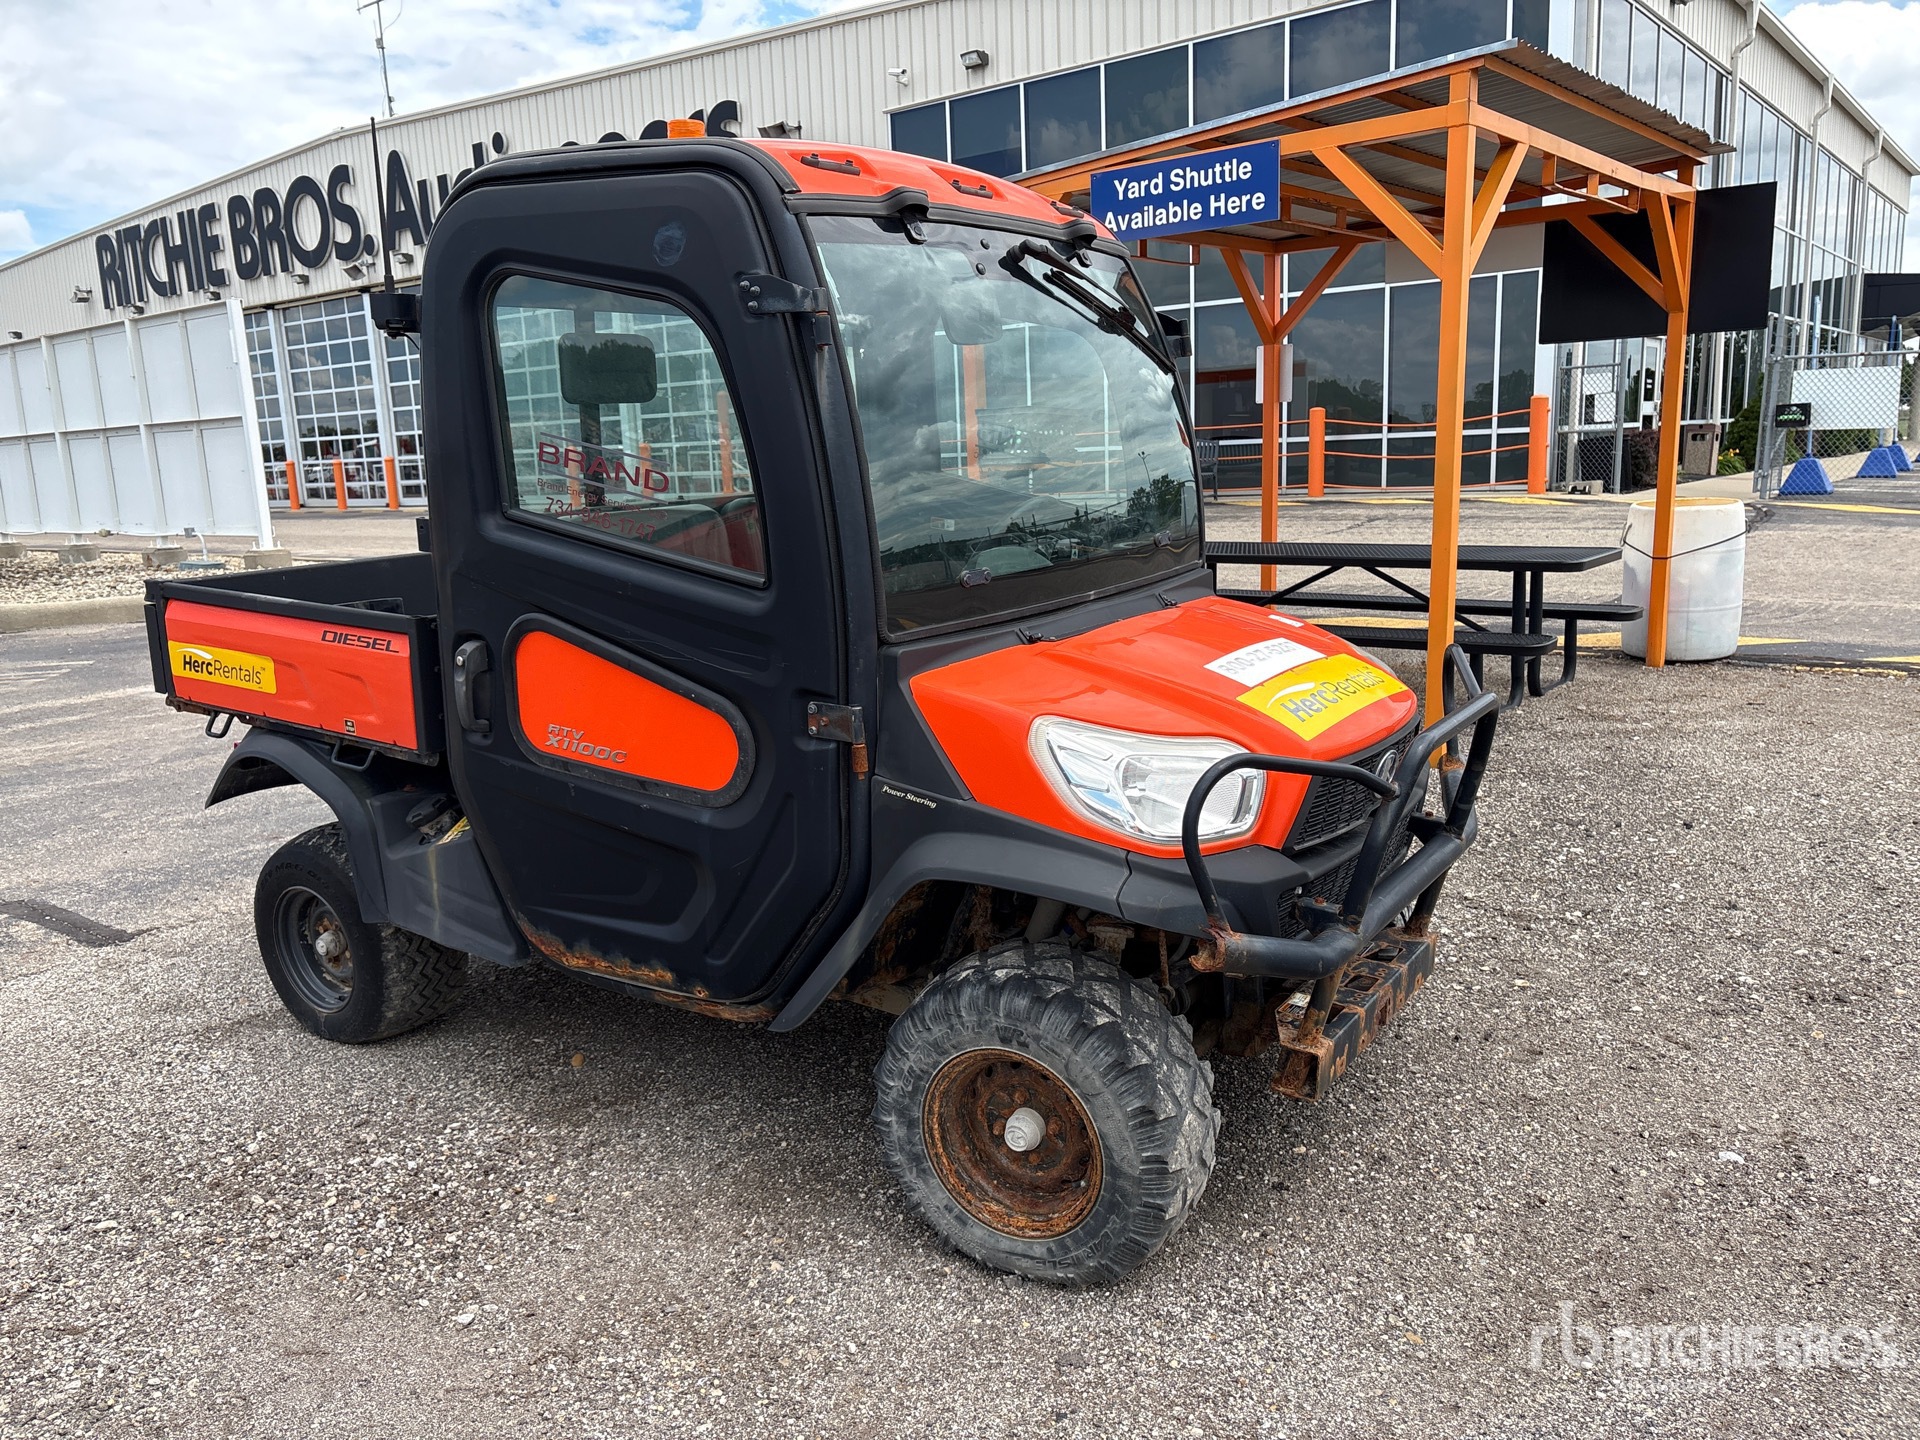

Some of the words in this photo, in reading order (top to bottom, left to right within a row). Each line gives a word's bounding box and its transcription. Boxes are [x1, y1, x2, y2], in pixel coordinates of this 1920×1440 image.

[1113, 172, 1163, 201] Yard
[1169, 158, 1253, 192] Shuttle
[1104, 199, 1202, 232] Available
[1209, 192, 1266, 217] Here
[95, 202, 229, 310] RITCHIE
[227, 163, 378, 280] BROS.
[538, 441, 670, 493] BRAND
[537, 477, 564, 493] Brand
[321, 630, 400, 653] DIESEL
[182, 654, 263, 685] HercRentals
[1280, 668, 1385, 722] HercRentals
[547, 723, 585, 739] RTV
[545, 734, 628, 763] X1100C
[881, 784, 906, 798] Power
[905, 792, 937, 809] Steering
